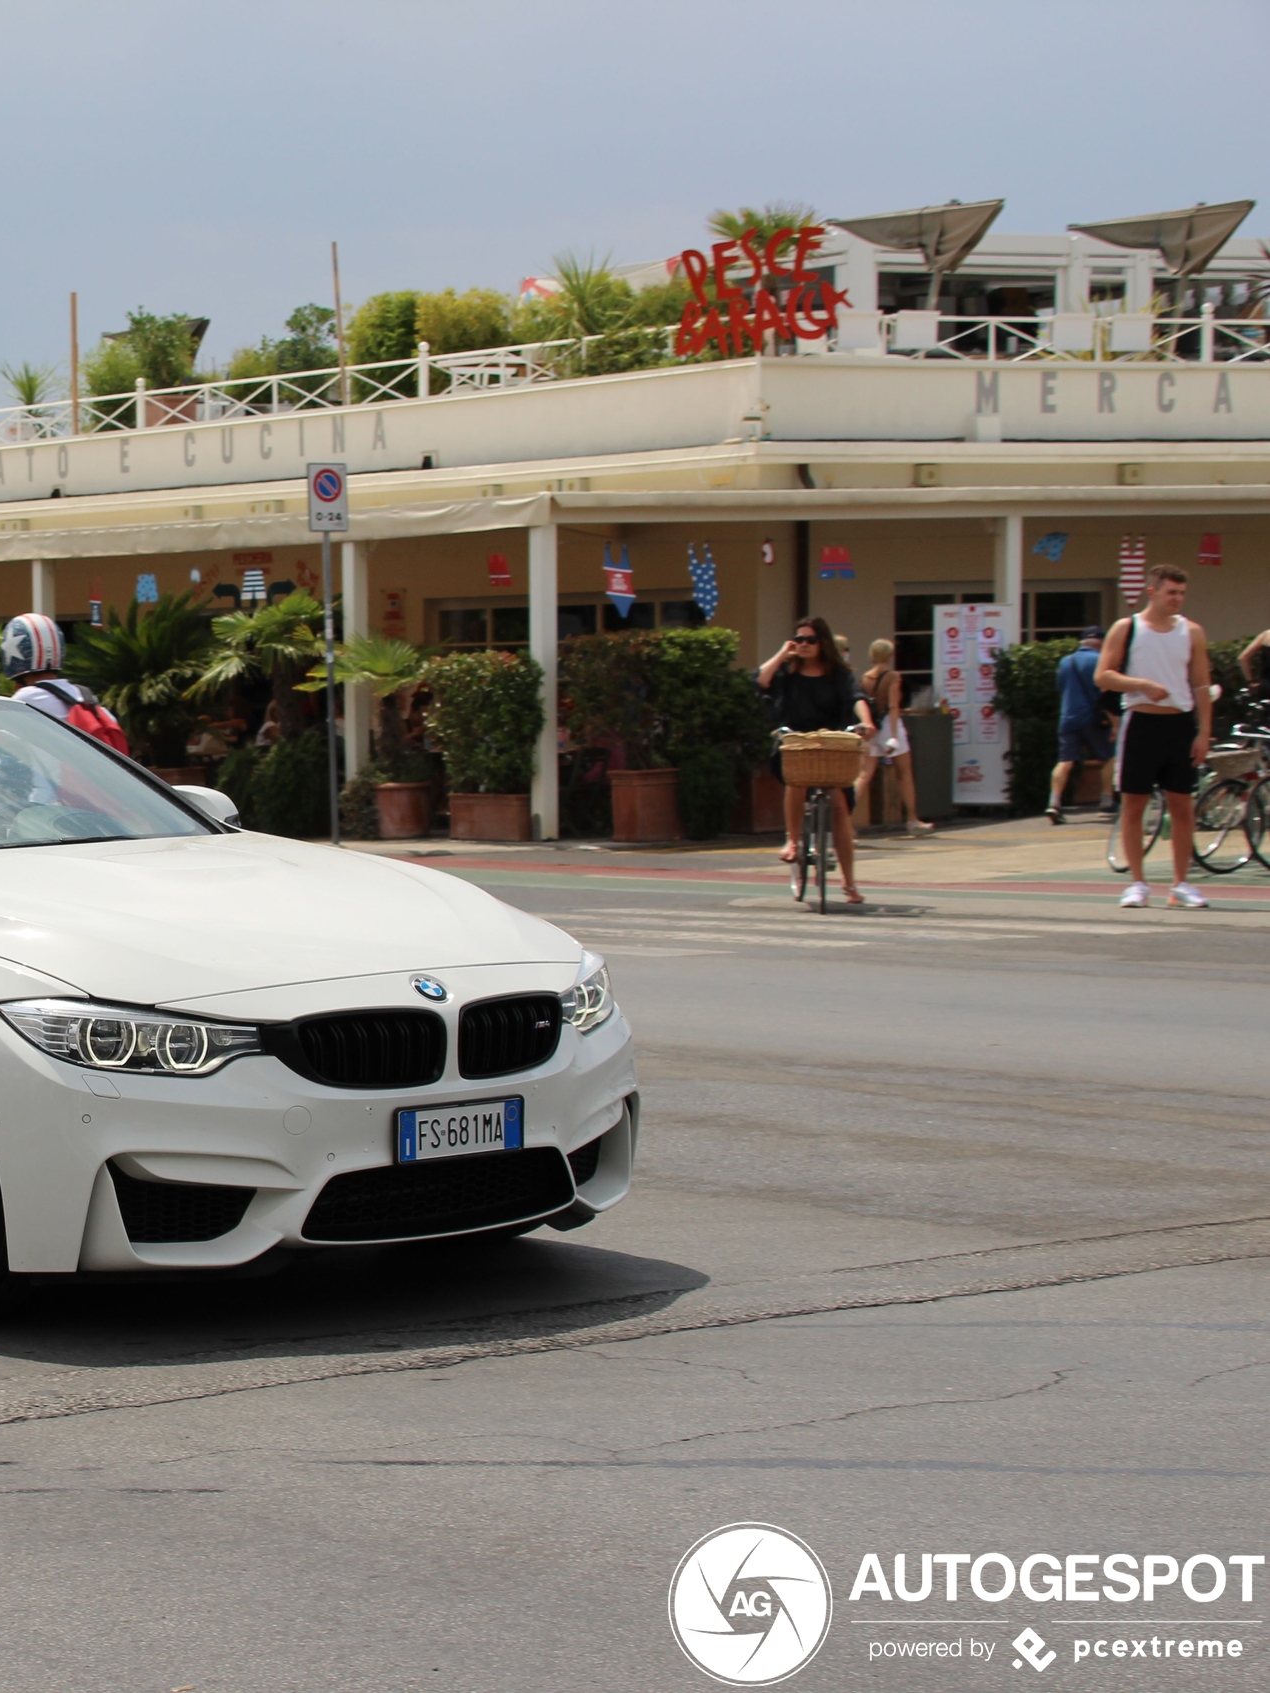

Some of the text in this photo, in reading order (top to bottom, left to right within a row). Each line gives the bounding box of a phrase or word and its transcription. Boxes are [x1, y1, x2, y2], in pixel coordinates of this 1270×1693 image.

[681, 226, 825, 307] PESCE
[675, 280, 855, 357] BARACCA
[119, 437, 131, 474] E
[183, 409, 387, 468] CUCINA
[315, 511, 343, 522] 0-24
